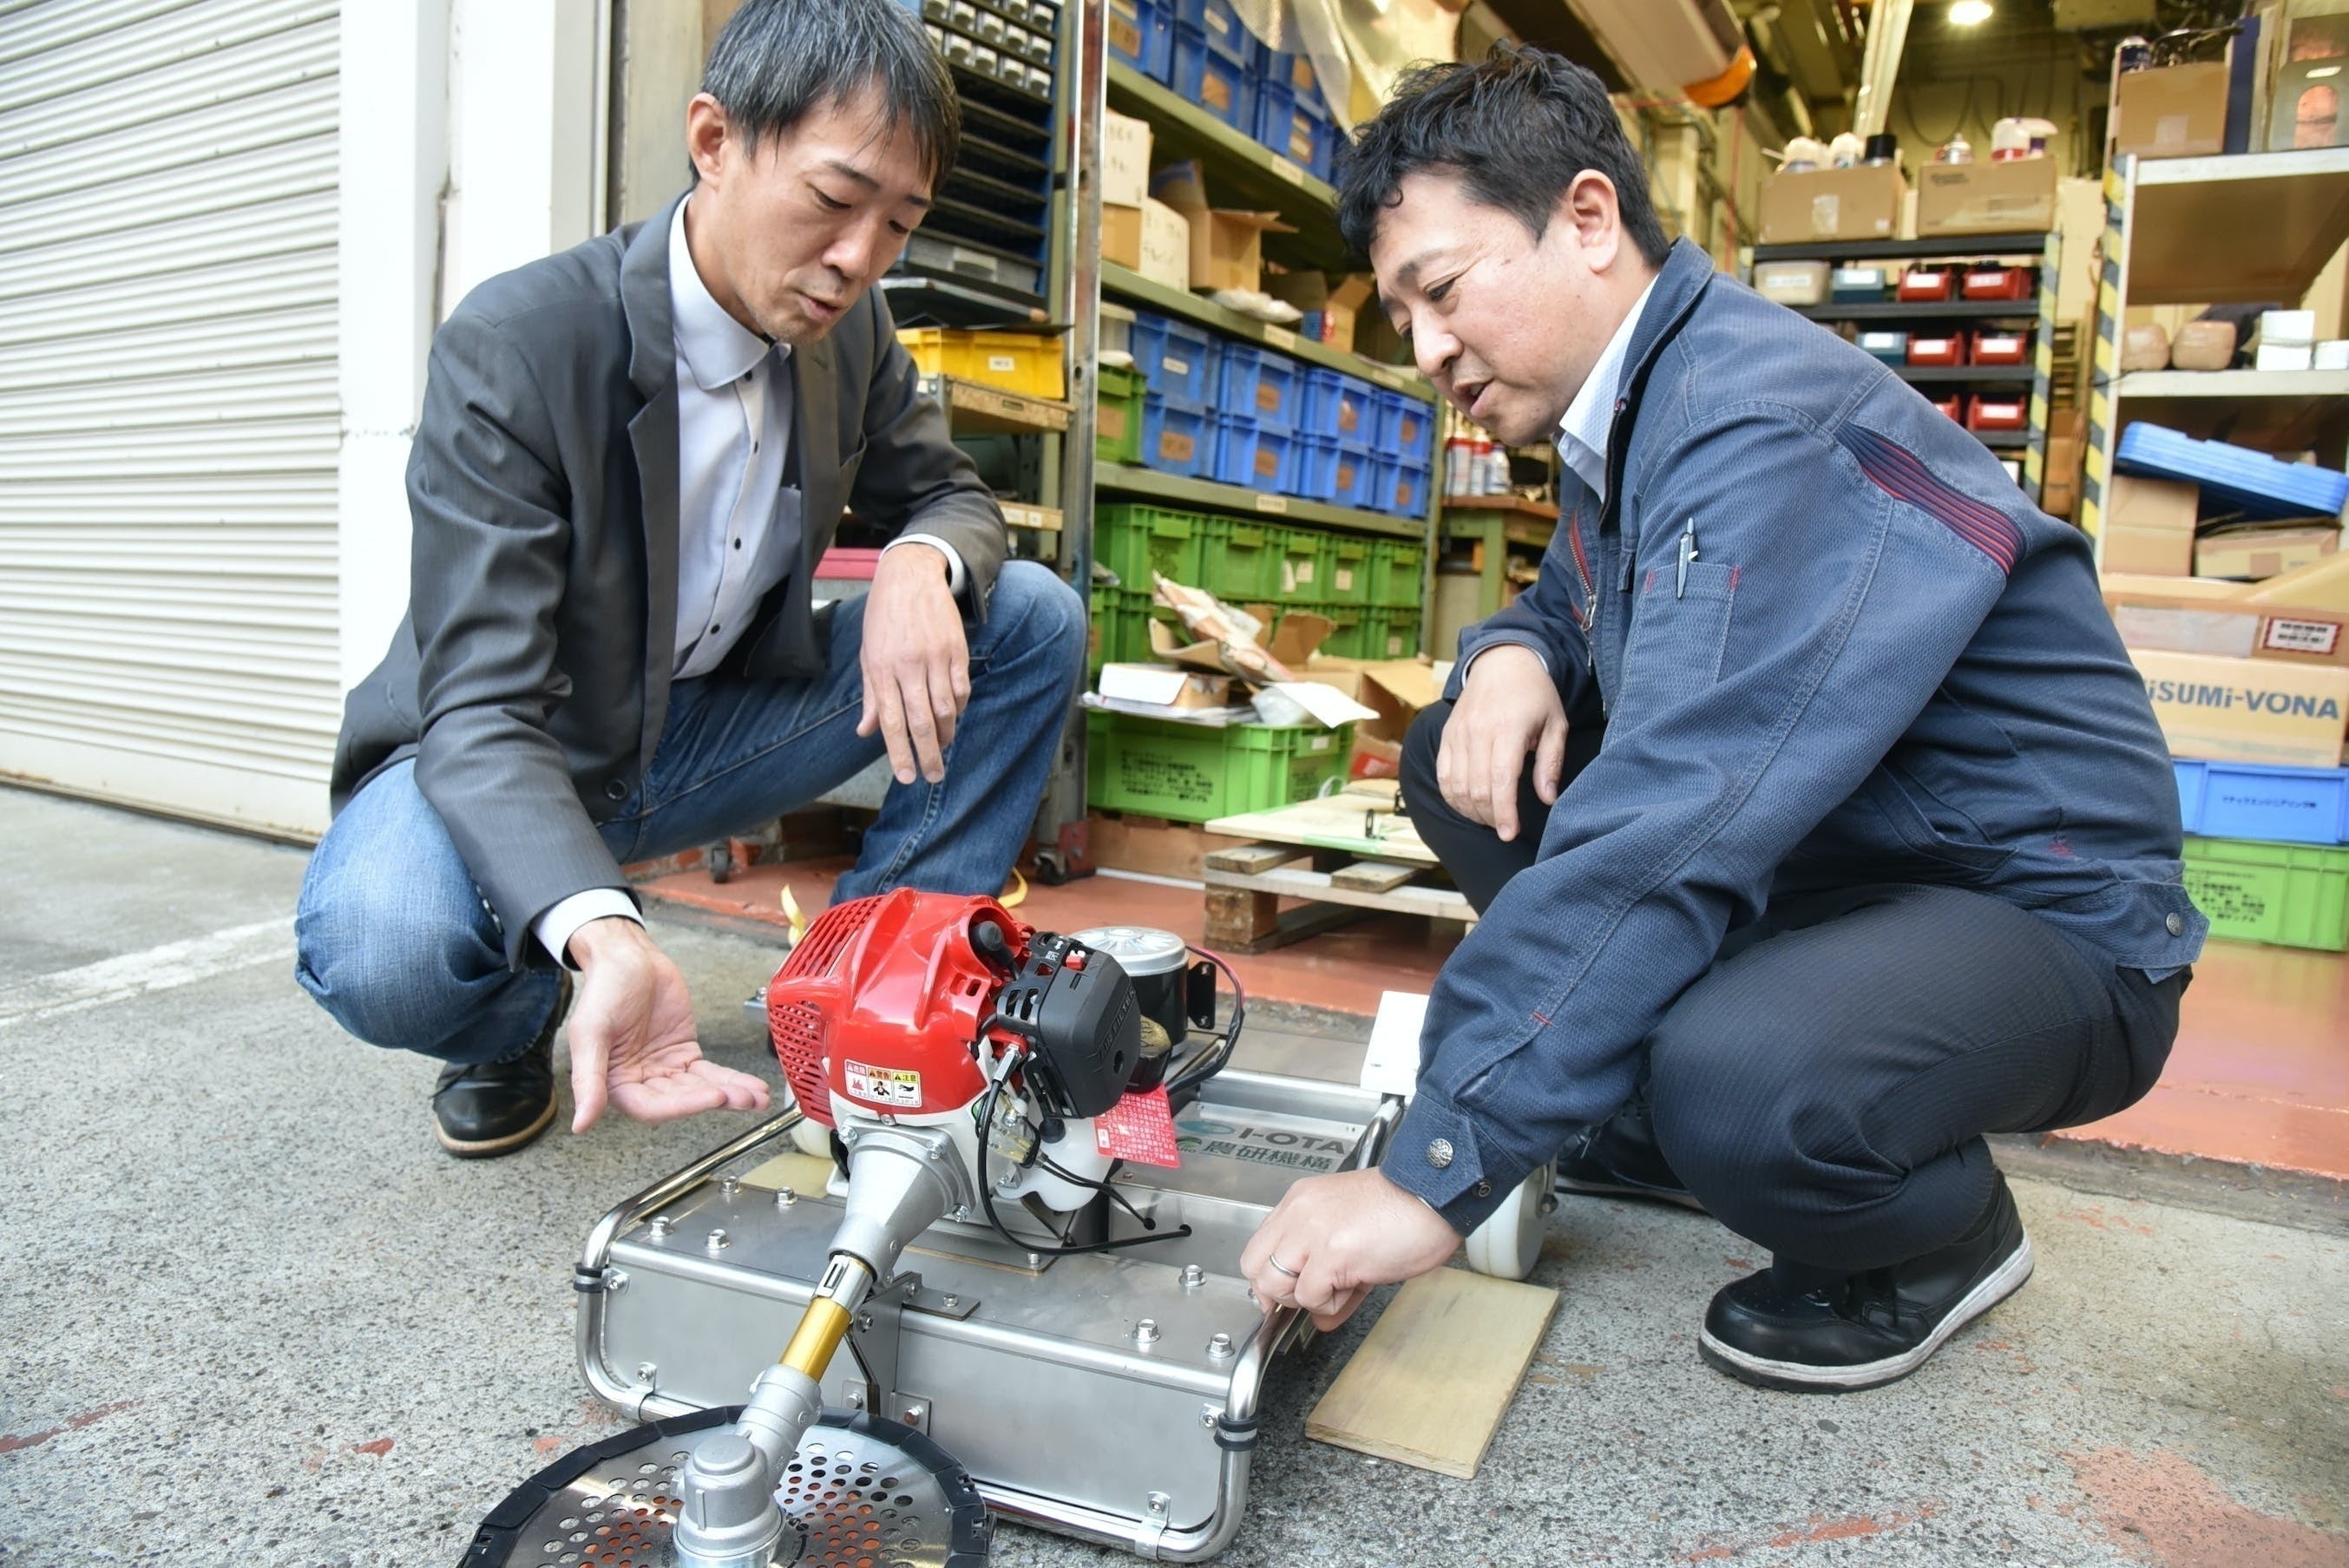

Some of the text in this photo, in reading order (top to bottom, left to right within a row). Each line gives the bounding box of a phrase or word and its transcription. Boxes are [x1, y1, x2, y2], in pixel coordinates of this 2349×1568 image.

[876, 1070, 890, 1080] 警告
[1237, 1127, 1345, 1155] I-OTA
[1204, 1140, 1334, 1171] 農研機構
